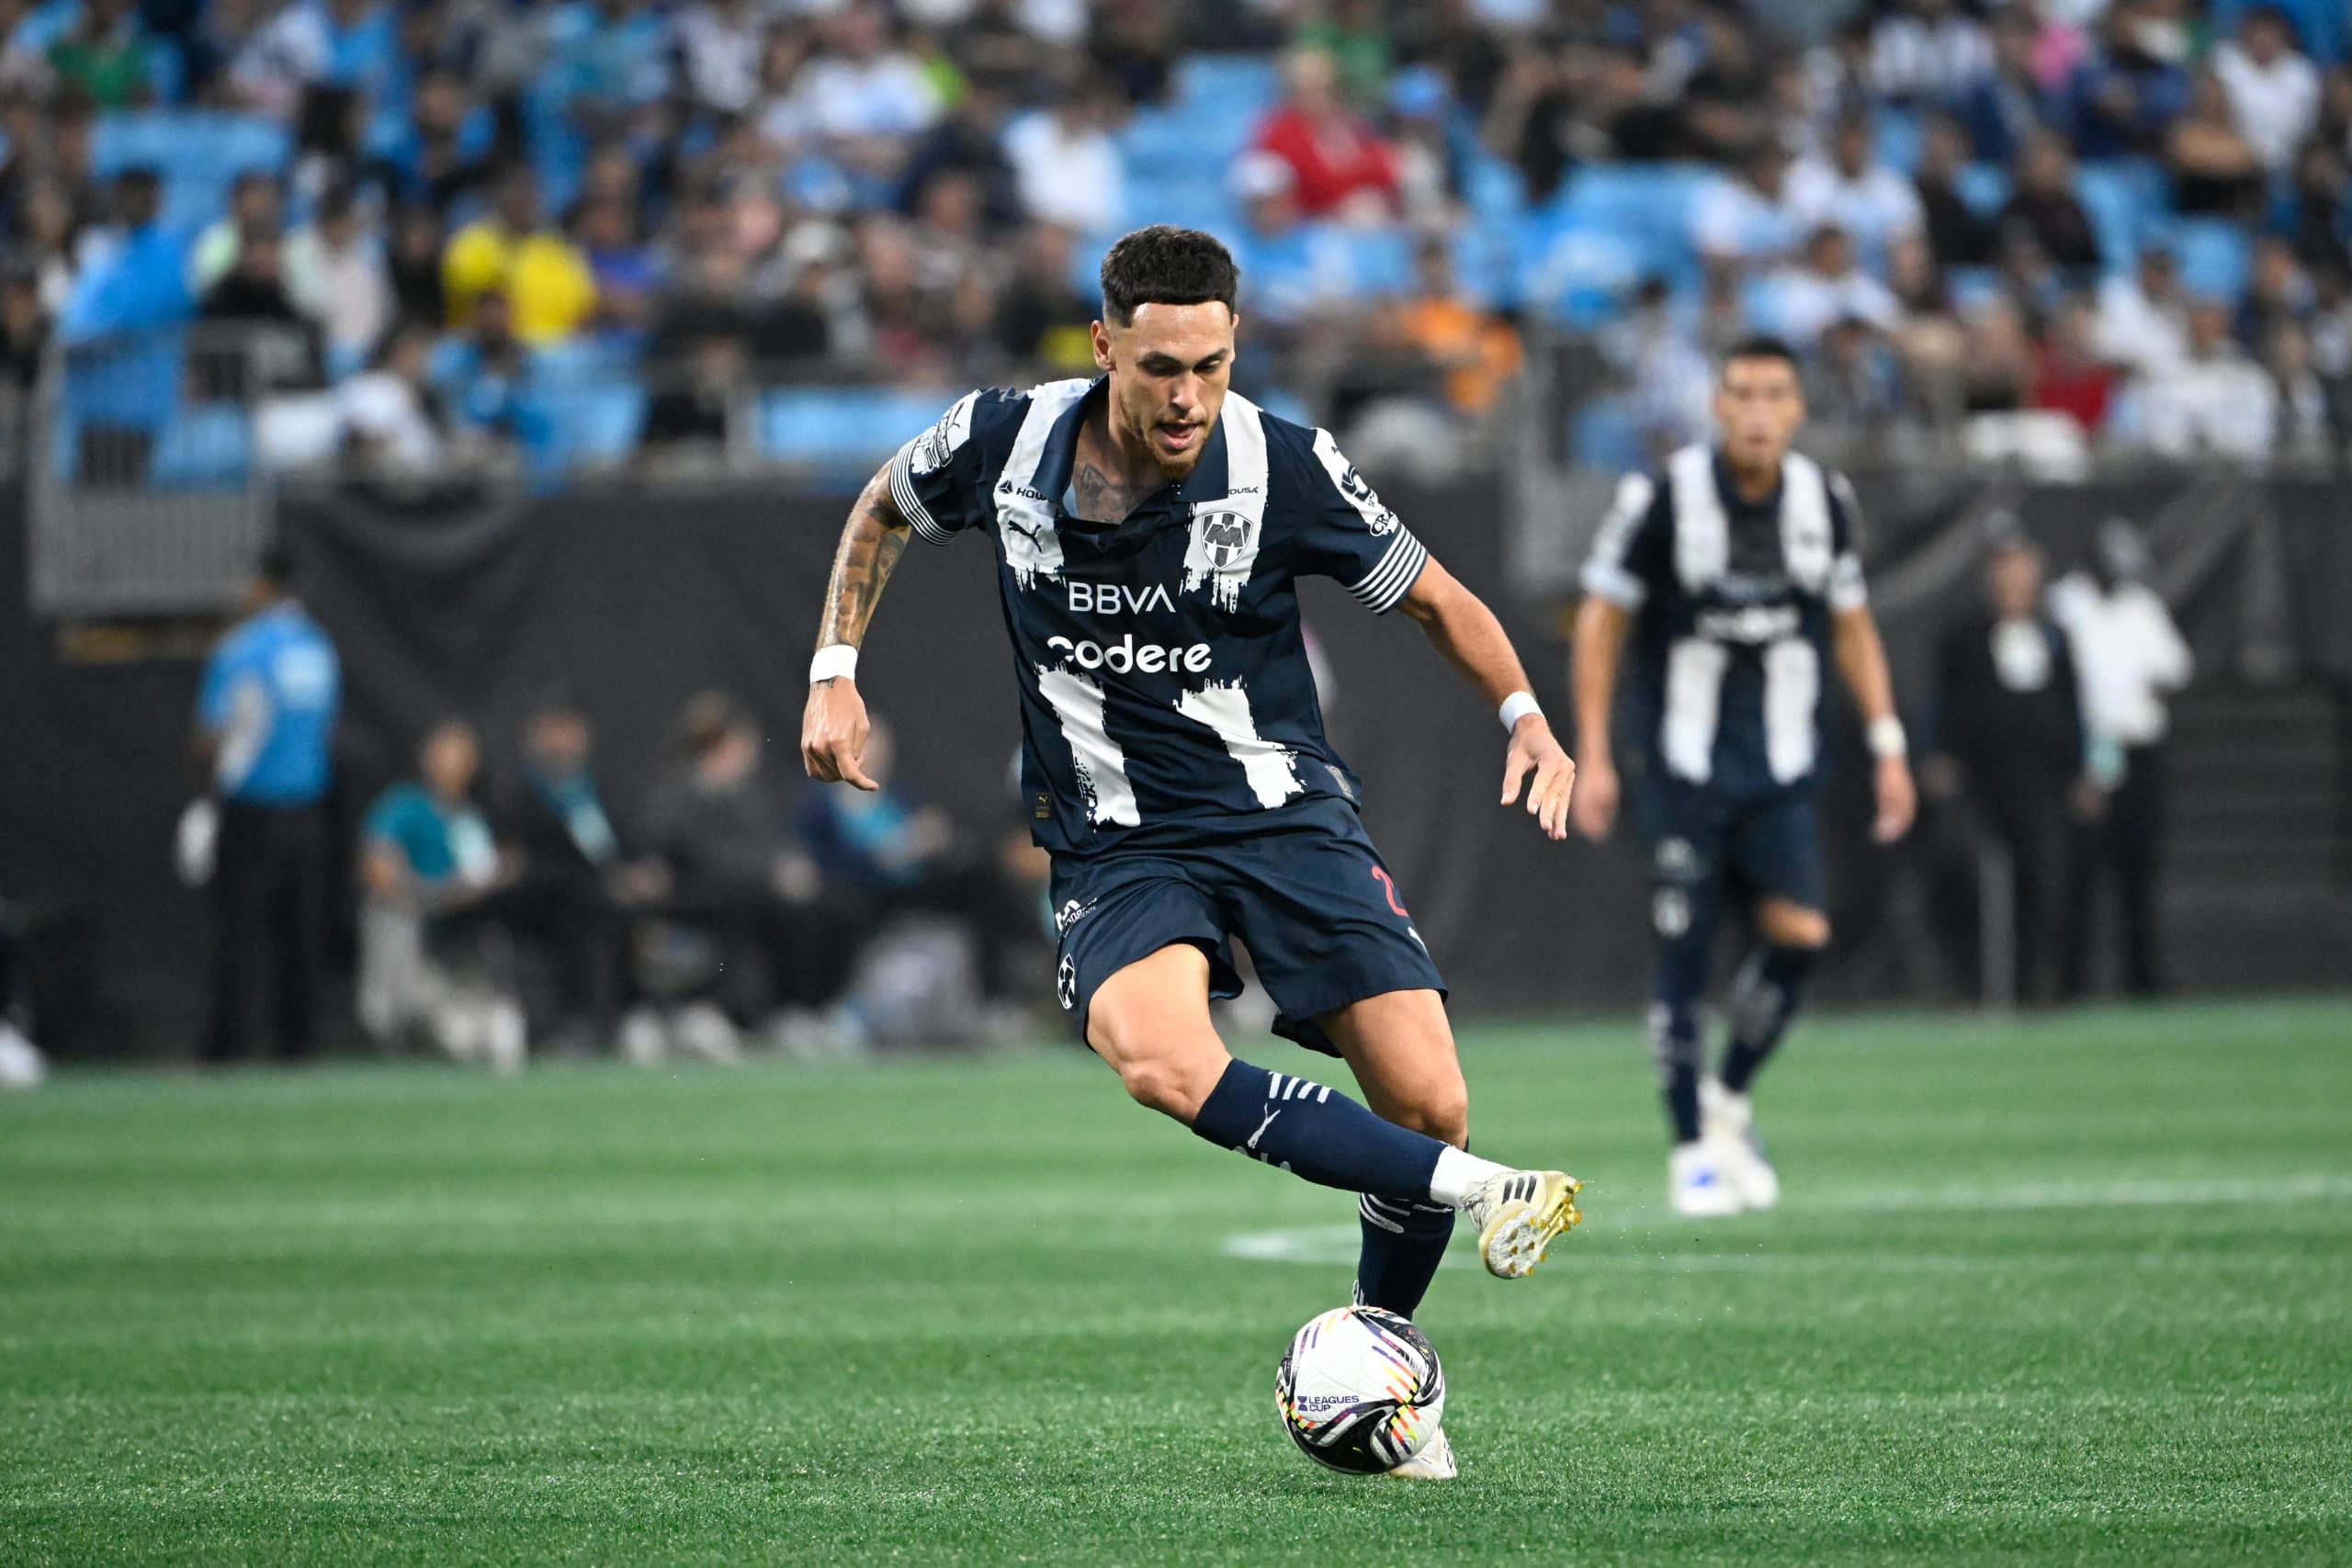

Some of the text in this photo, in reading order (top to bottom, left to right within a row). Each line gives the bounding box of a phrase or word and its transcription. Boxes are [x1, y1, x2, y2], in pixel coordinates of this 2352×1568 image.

[1227, 486, 1259, 495] DUSA
[1069, 581, 1177, 615] BBVA
[1308, 1395, 1360, 1404] LEAGUES
[1309, 1404, 1331, 1412] CUP
